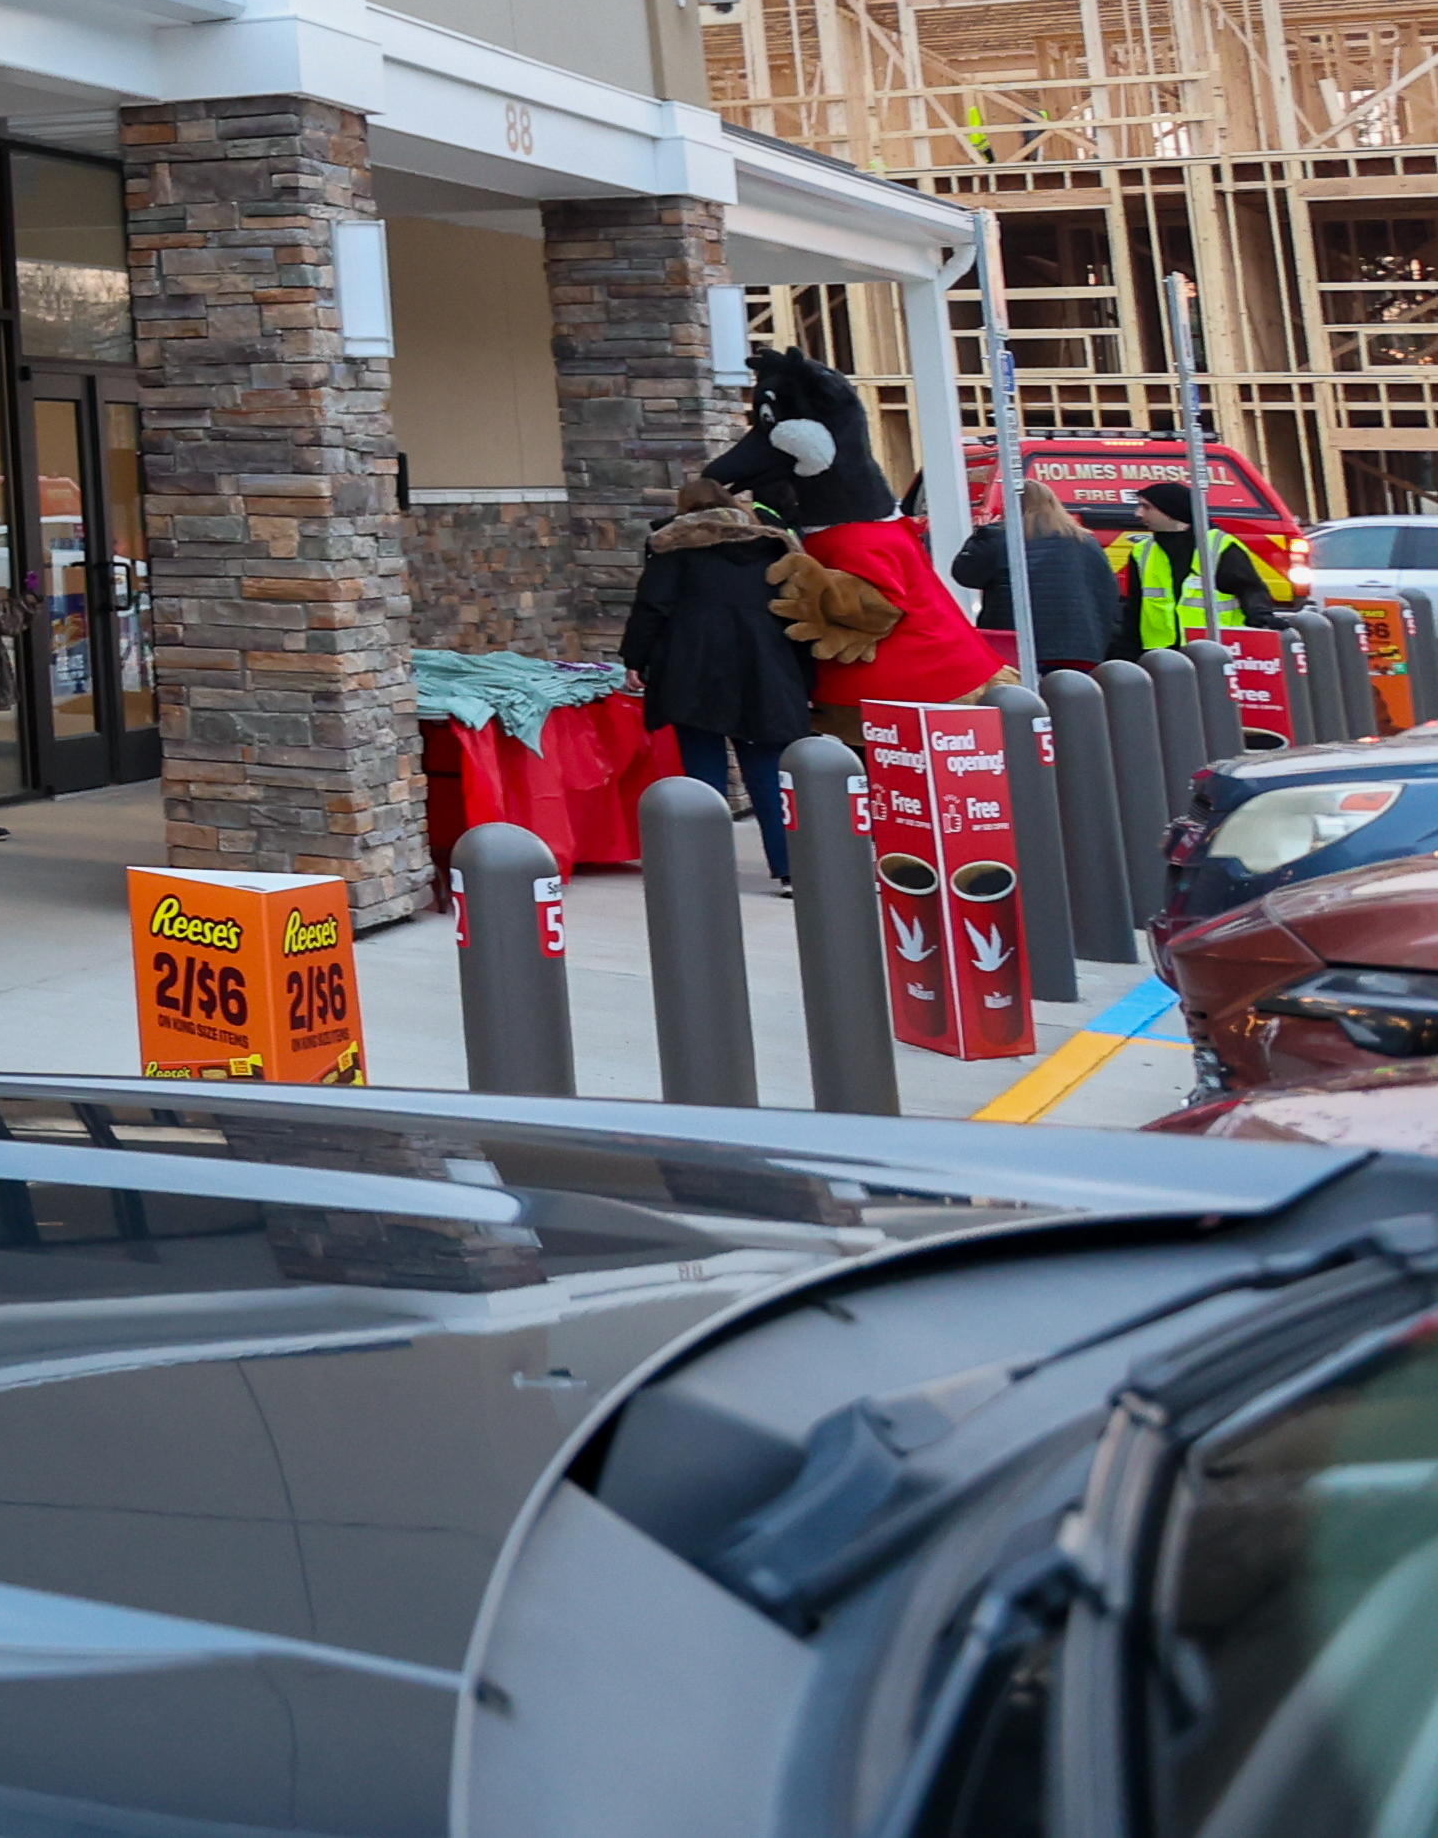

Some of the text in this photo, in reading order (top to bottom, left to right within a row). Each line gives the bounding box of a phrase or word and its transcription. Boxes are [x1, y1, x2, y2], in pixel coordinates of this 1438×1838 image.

[506, 102, 533, 156] 88
[1034, 462, 1236, 486] HOLMES MARSHLL
[1074, 490, 1119, 502] FIRE
[1237, 689, 1271, 702] ree
[862, 721, 899, 745] Grand
[932, 728, 976, 751] Grand
[874, 747, 927, 774] opening!
[1041, 734, 1055, 762] 5
[947, 750, 1005, 777] opening!
[856, 797, 872, 831] 5
[890, 790, 922, 815] Free
[966, 797, 1000, 819] Free
[151, 895, 242, 950] Reese's
[284, 909, 338, 955] Reese's
[546, 906, 565, 951] 5
[153, 951, 248, 1026] 2/$6
[287, 962, 347, 1031] 2/$6
[197, 1023, 219, 1041] SIZE
[220, 1029, 249, 1050] ITEMS
